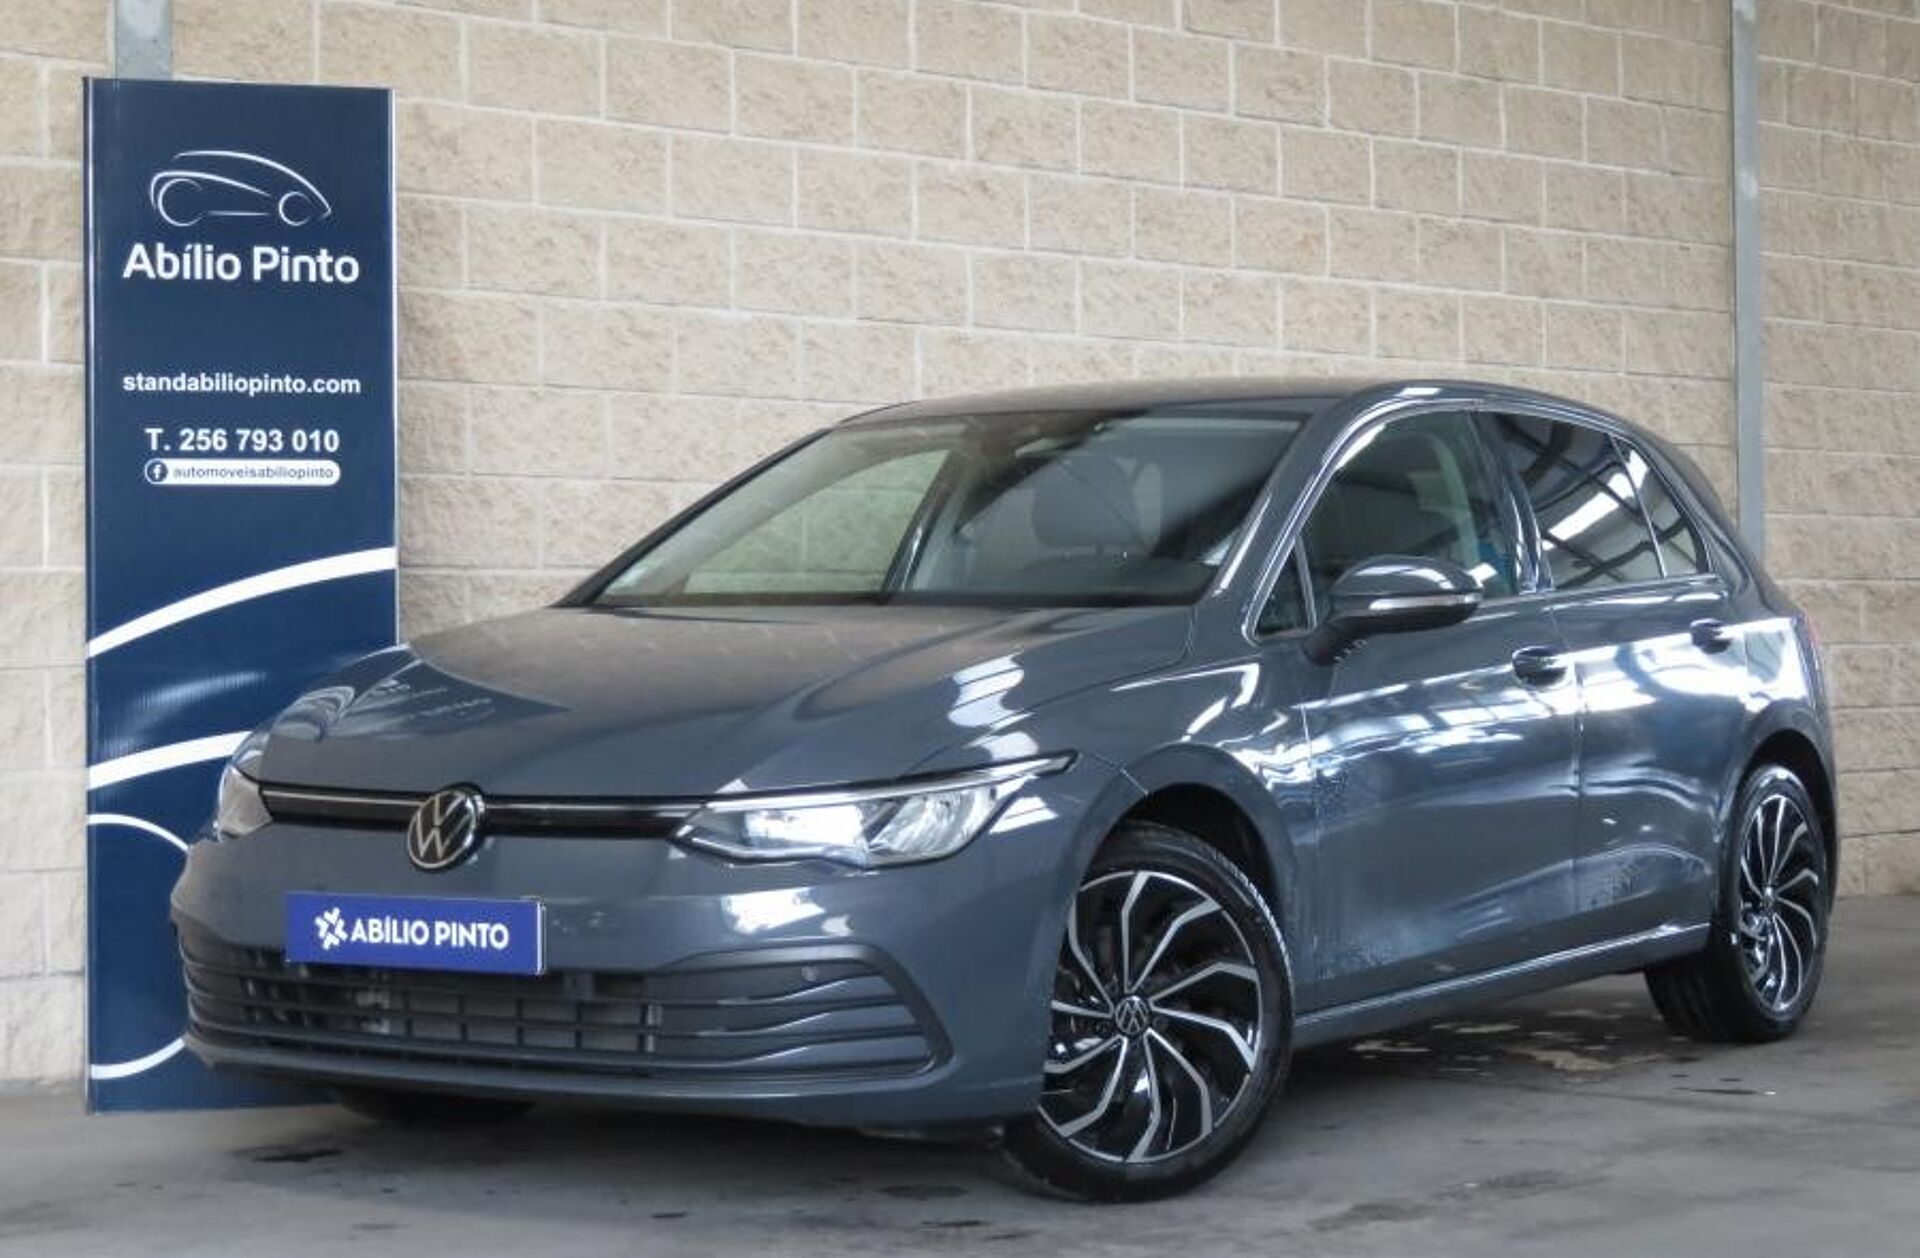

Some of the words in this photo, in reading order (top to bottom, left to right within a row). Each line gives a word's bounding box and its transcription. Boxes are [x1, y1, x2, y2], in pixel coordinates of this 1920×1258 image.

[122, 243, 242, 280] Abílio
[253, 246, 360, 283] Pinto
[122, 373, 361, 396] standabiliopinto.com
[145, 428, 171, 451] T.
[179, 428, 228, 452] 256
[236, 429, 283, 452] 793
[291, 430, 340, 453] 010
[172, 465, 334, 480] automoveisabiliopinto
[350, 915, 429, 945] ABÍLIO
[434, 921, 510, 949] PINTO
